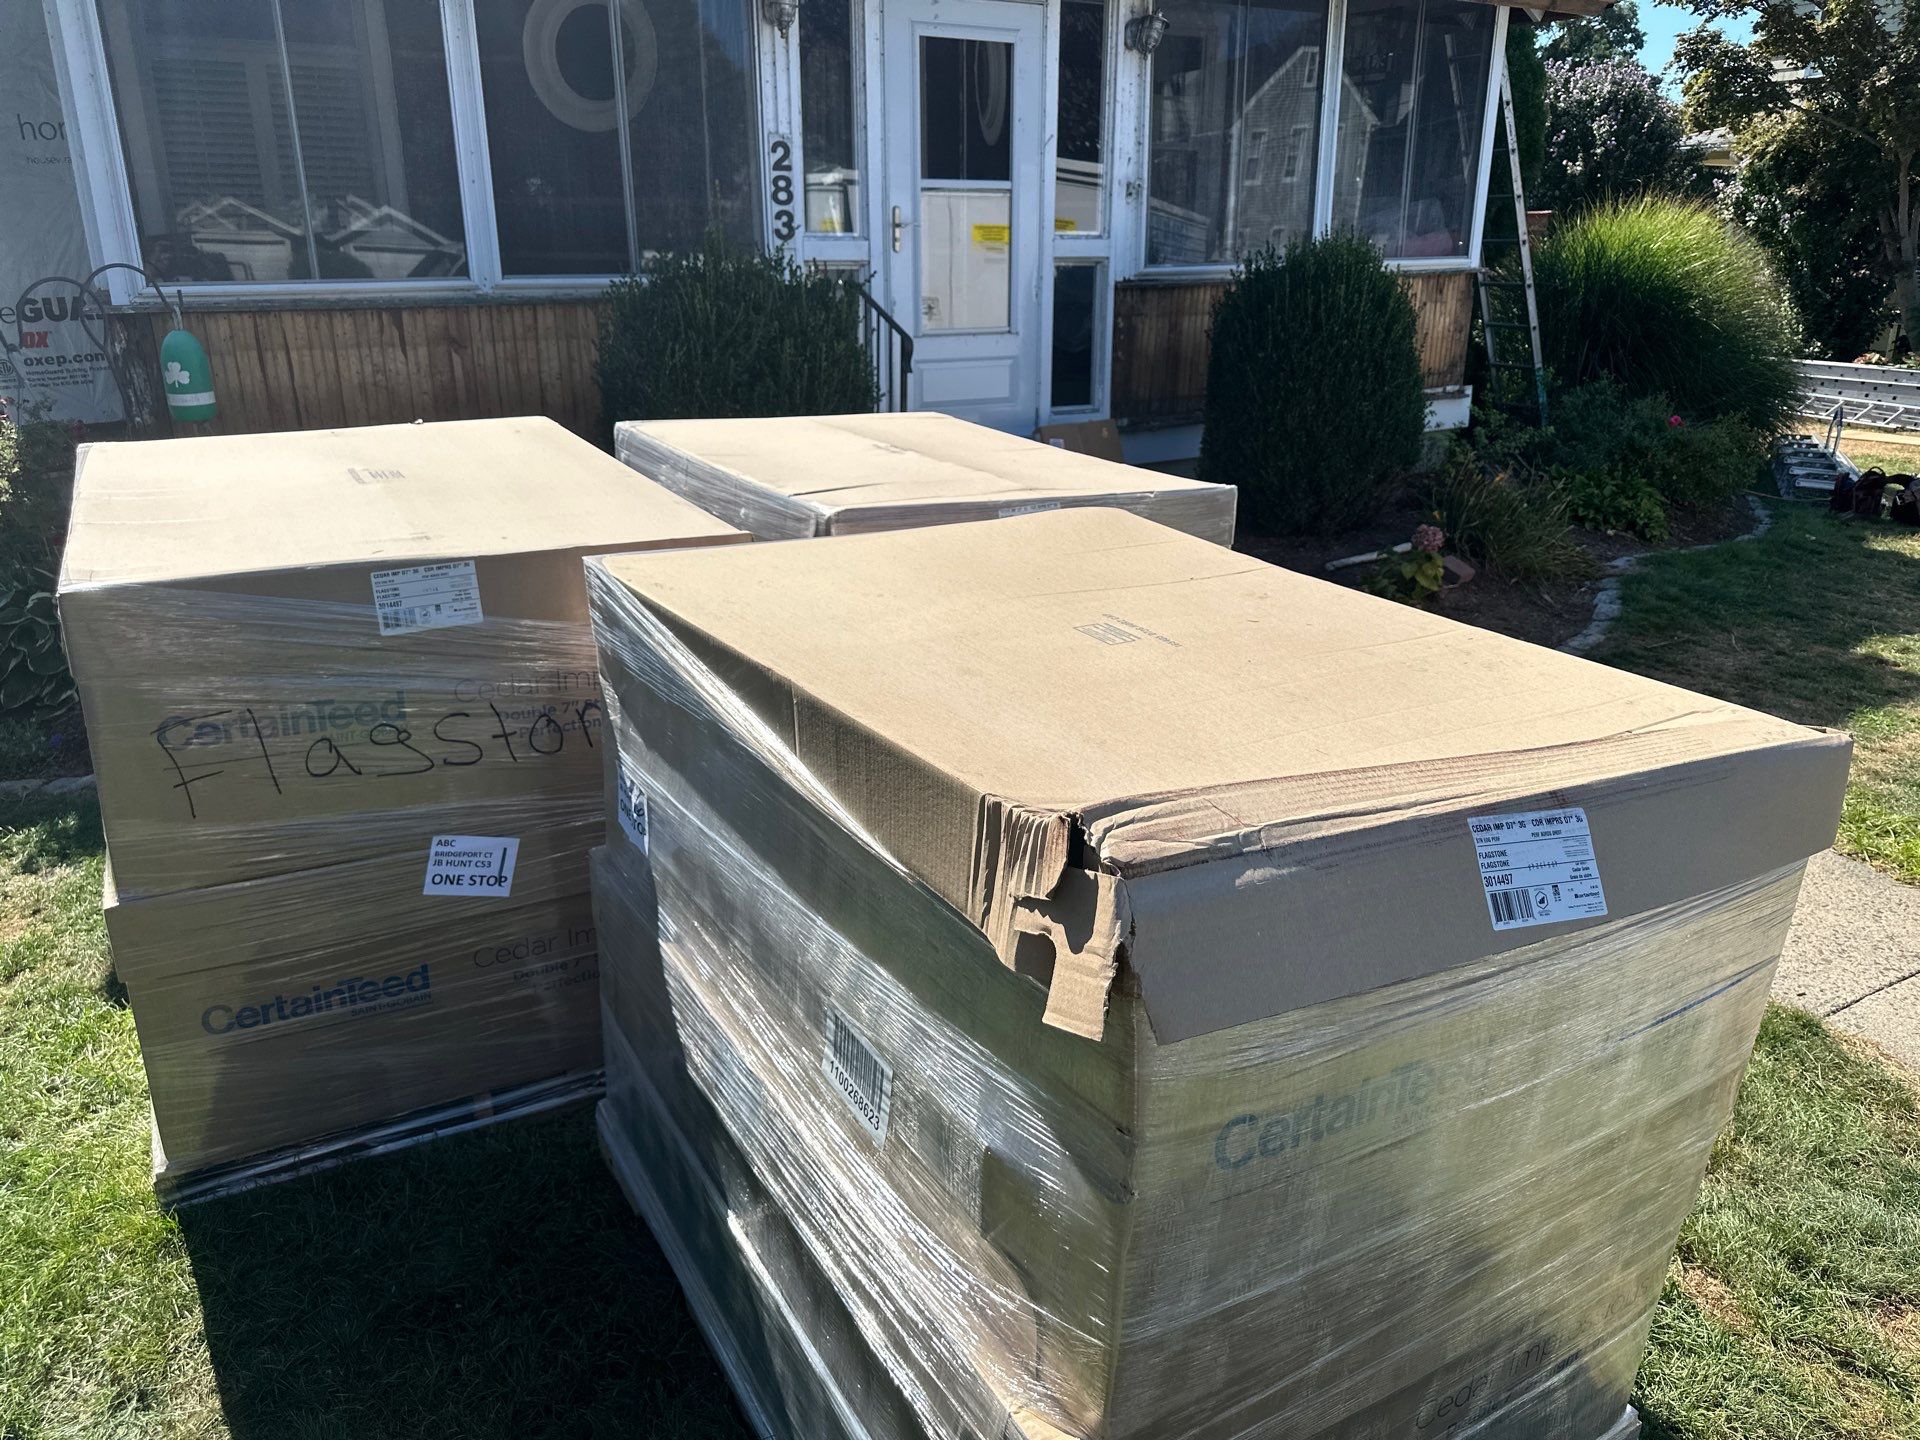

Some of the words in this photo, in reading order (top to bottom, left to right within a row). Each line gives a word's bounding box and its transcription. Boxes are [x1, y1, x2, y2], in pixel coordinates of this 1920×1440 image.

[771, 141, 796, 240] 283
[22, 331, 48, 349] OX
[454, 671, 546, 703] Cedar
[157, 691, 407, 750] CertainTeed
[1471, 822, 1492, 834] CEDAR
[1493, 820, 1504, 831] IMP
[1518, 819, 1527, 828] 3G
[1545, 815, 1563, 825] IMPRS
[436, 839, 456, 847] ABC
[434, 850, 482, 858] BRIDGEPORT
[1478, 849, 1508, 860] FLAGSTONE
[433, 859, 443, 867] JB
[446, 859, 473, 868] HUNT
[1480, 860, 1510, 870] FLAGSTONE
[431, 873, 465, 886] ONE
[468, 875, 508, 888] STOP
[1483, 873, 1513, 888] 3014497
[473, 937, 558, 968] Cedar
[201, 963, 431, 1035] CertainTeed
[351, 992, 433, 1018] SAINT-GOBAIN
[829, 1060, 880, 1131] 1100268623
